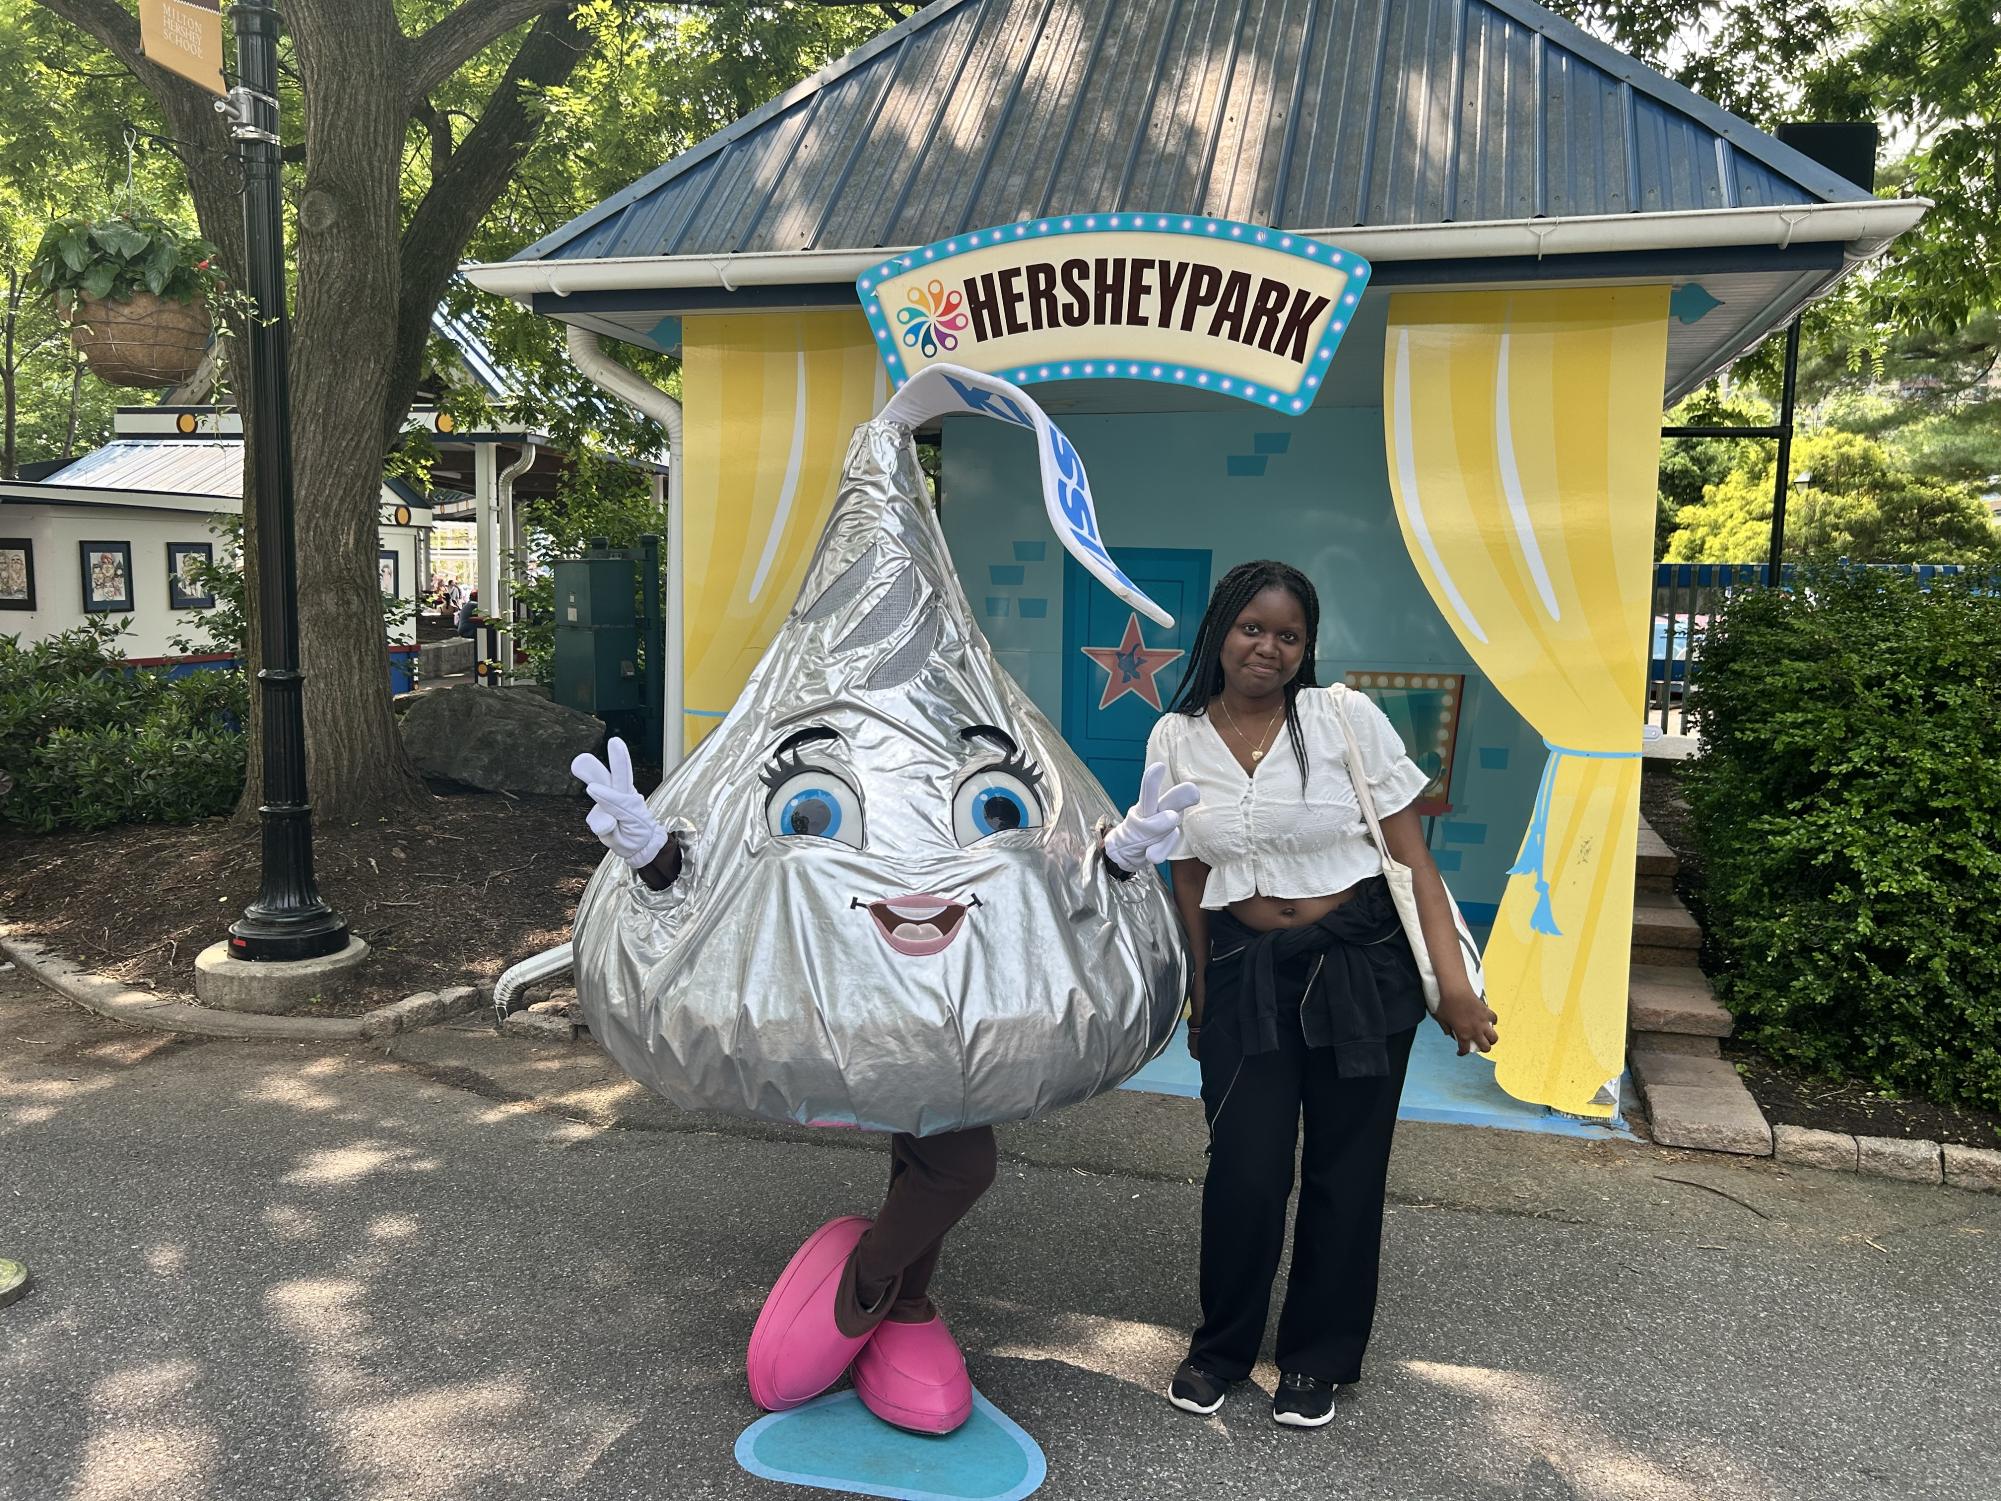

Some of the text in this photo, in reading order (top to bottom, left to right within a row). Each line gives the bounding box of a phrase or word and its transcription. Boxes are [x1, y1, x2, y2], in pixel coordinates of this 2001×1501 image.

[163, 3, 202, 34] MILTON
[163, 15, 202, 46] HERSHEY
[163, 29, 204, 59] SCHOOL
[963, 257, 1331, 364] HERSHEYPARK
